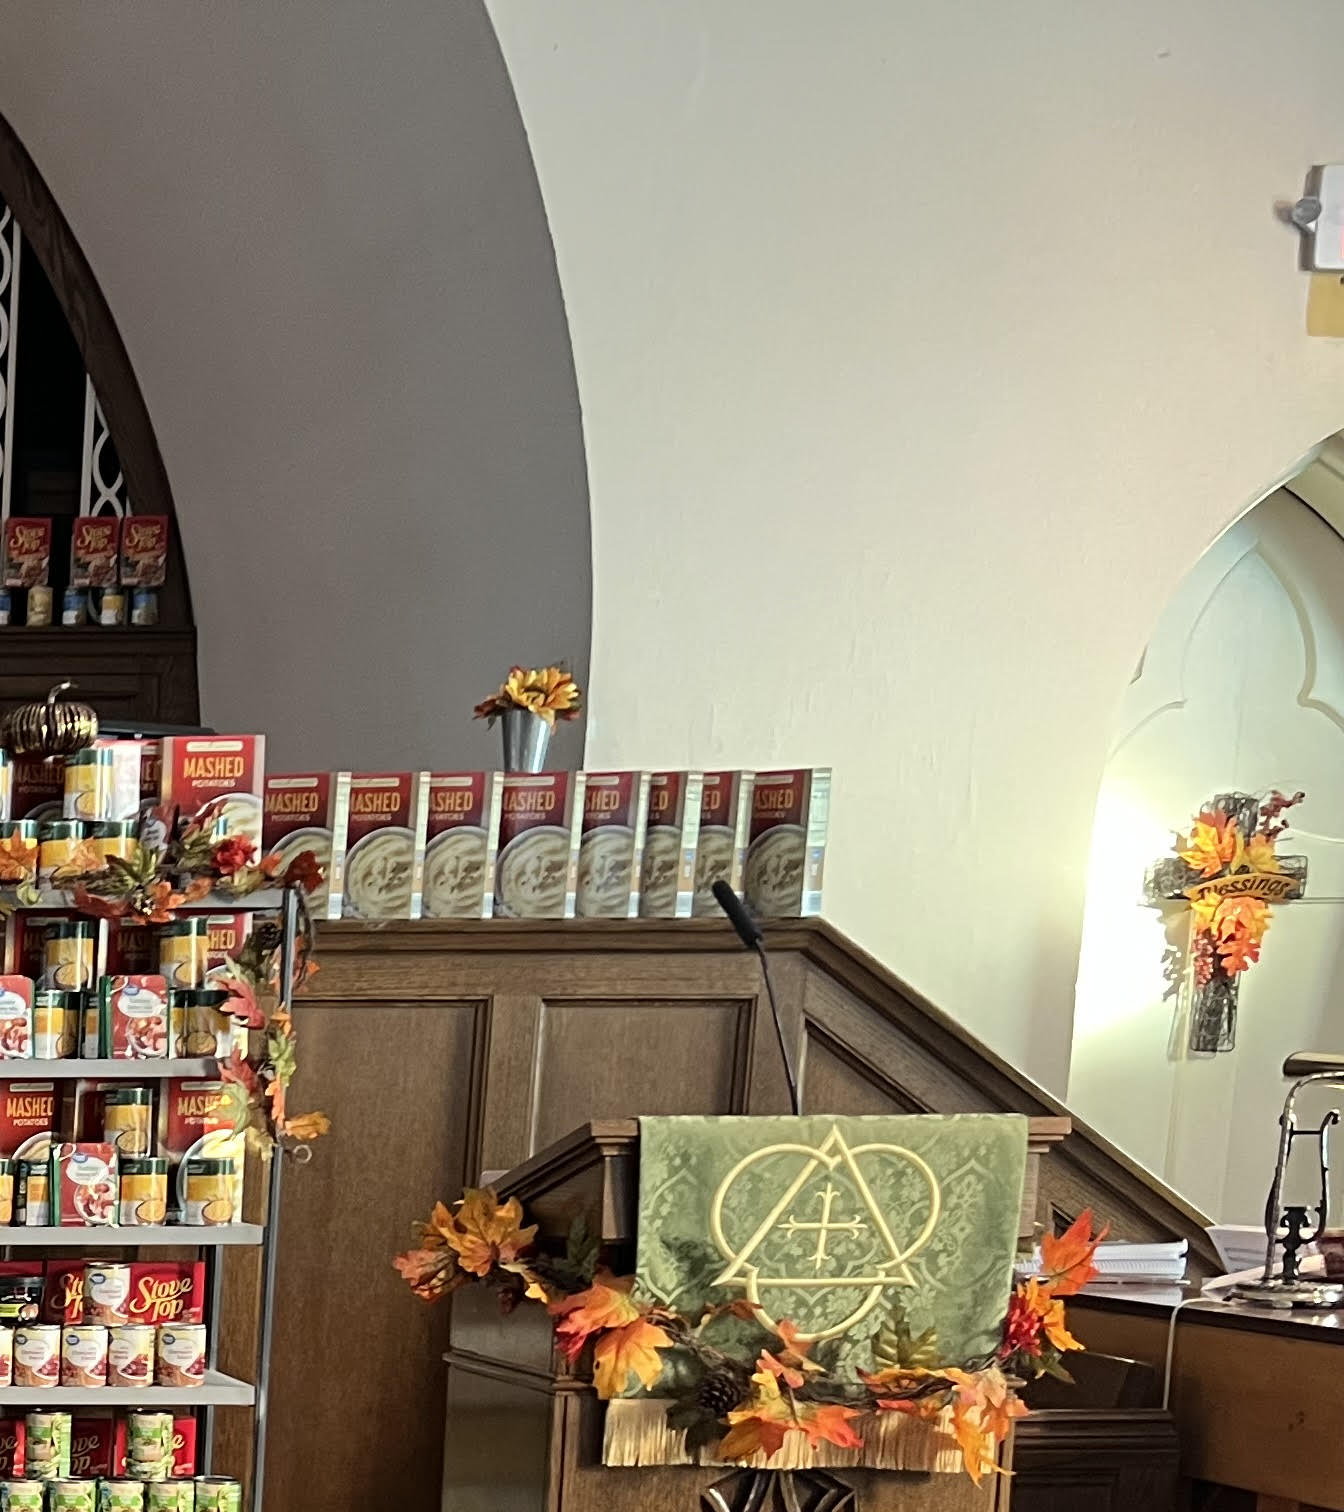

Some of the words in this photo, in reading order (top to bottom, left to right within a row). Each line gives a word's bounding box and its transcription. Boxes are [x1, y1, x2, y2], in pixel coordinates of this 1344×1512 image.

[184, 757, 244, 778] MASHED
[431, 791, 473, 812] ASHED
[7, 1096, 53, 1117] MASHED
[130, 1275, 194, 1312] Stove
[152, 1294, 183, 1319] Top
